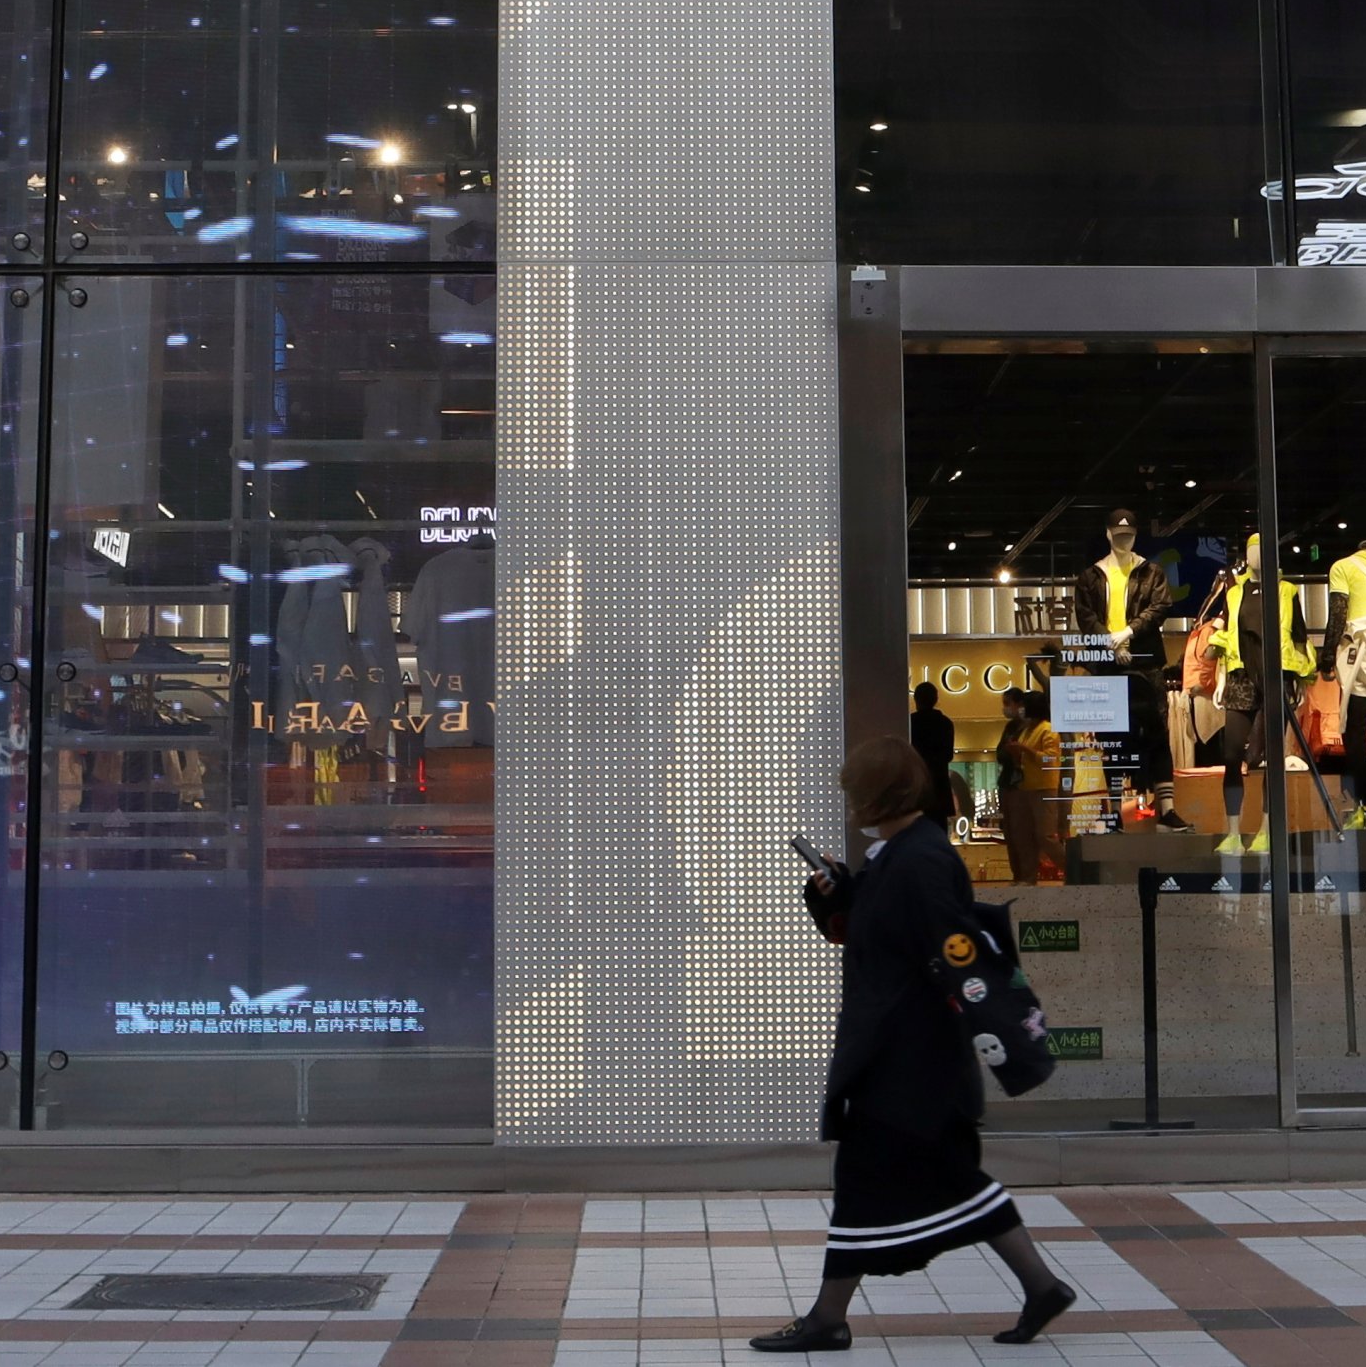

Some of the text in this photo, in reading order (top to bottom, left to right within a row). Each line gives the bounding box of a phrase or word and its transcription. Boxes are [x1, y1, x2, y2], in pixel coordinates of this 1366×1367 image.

[1060, 650, 1115, 662] TO ADIDAS
[1039, 925, 1077, 939] 小心台阶
[1060, 1033, 1100, 1047] 小心台阶
